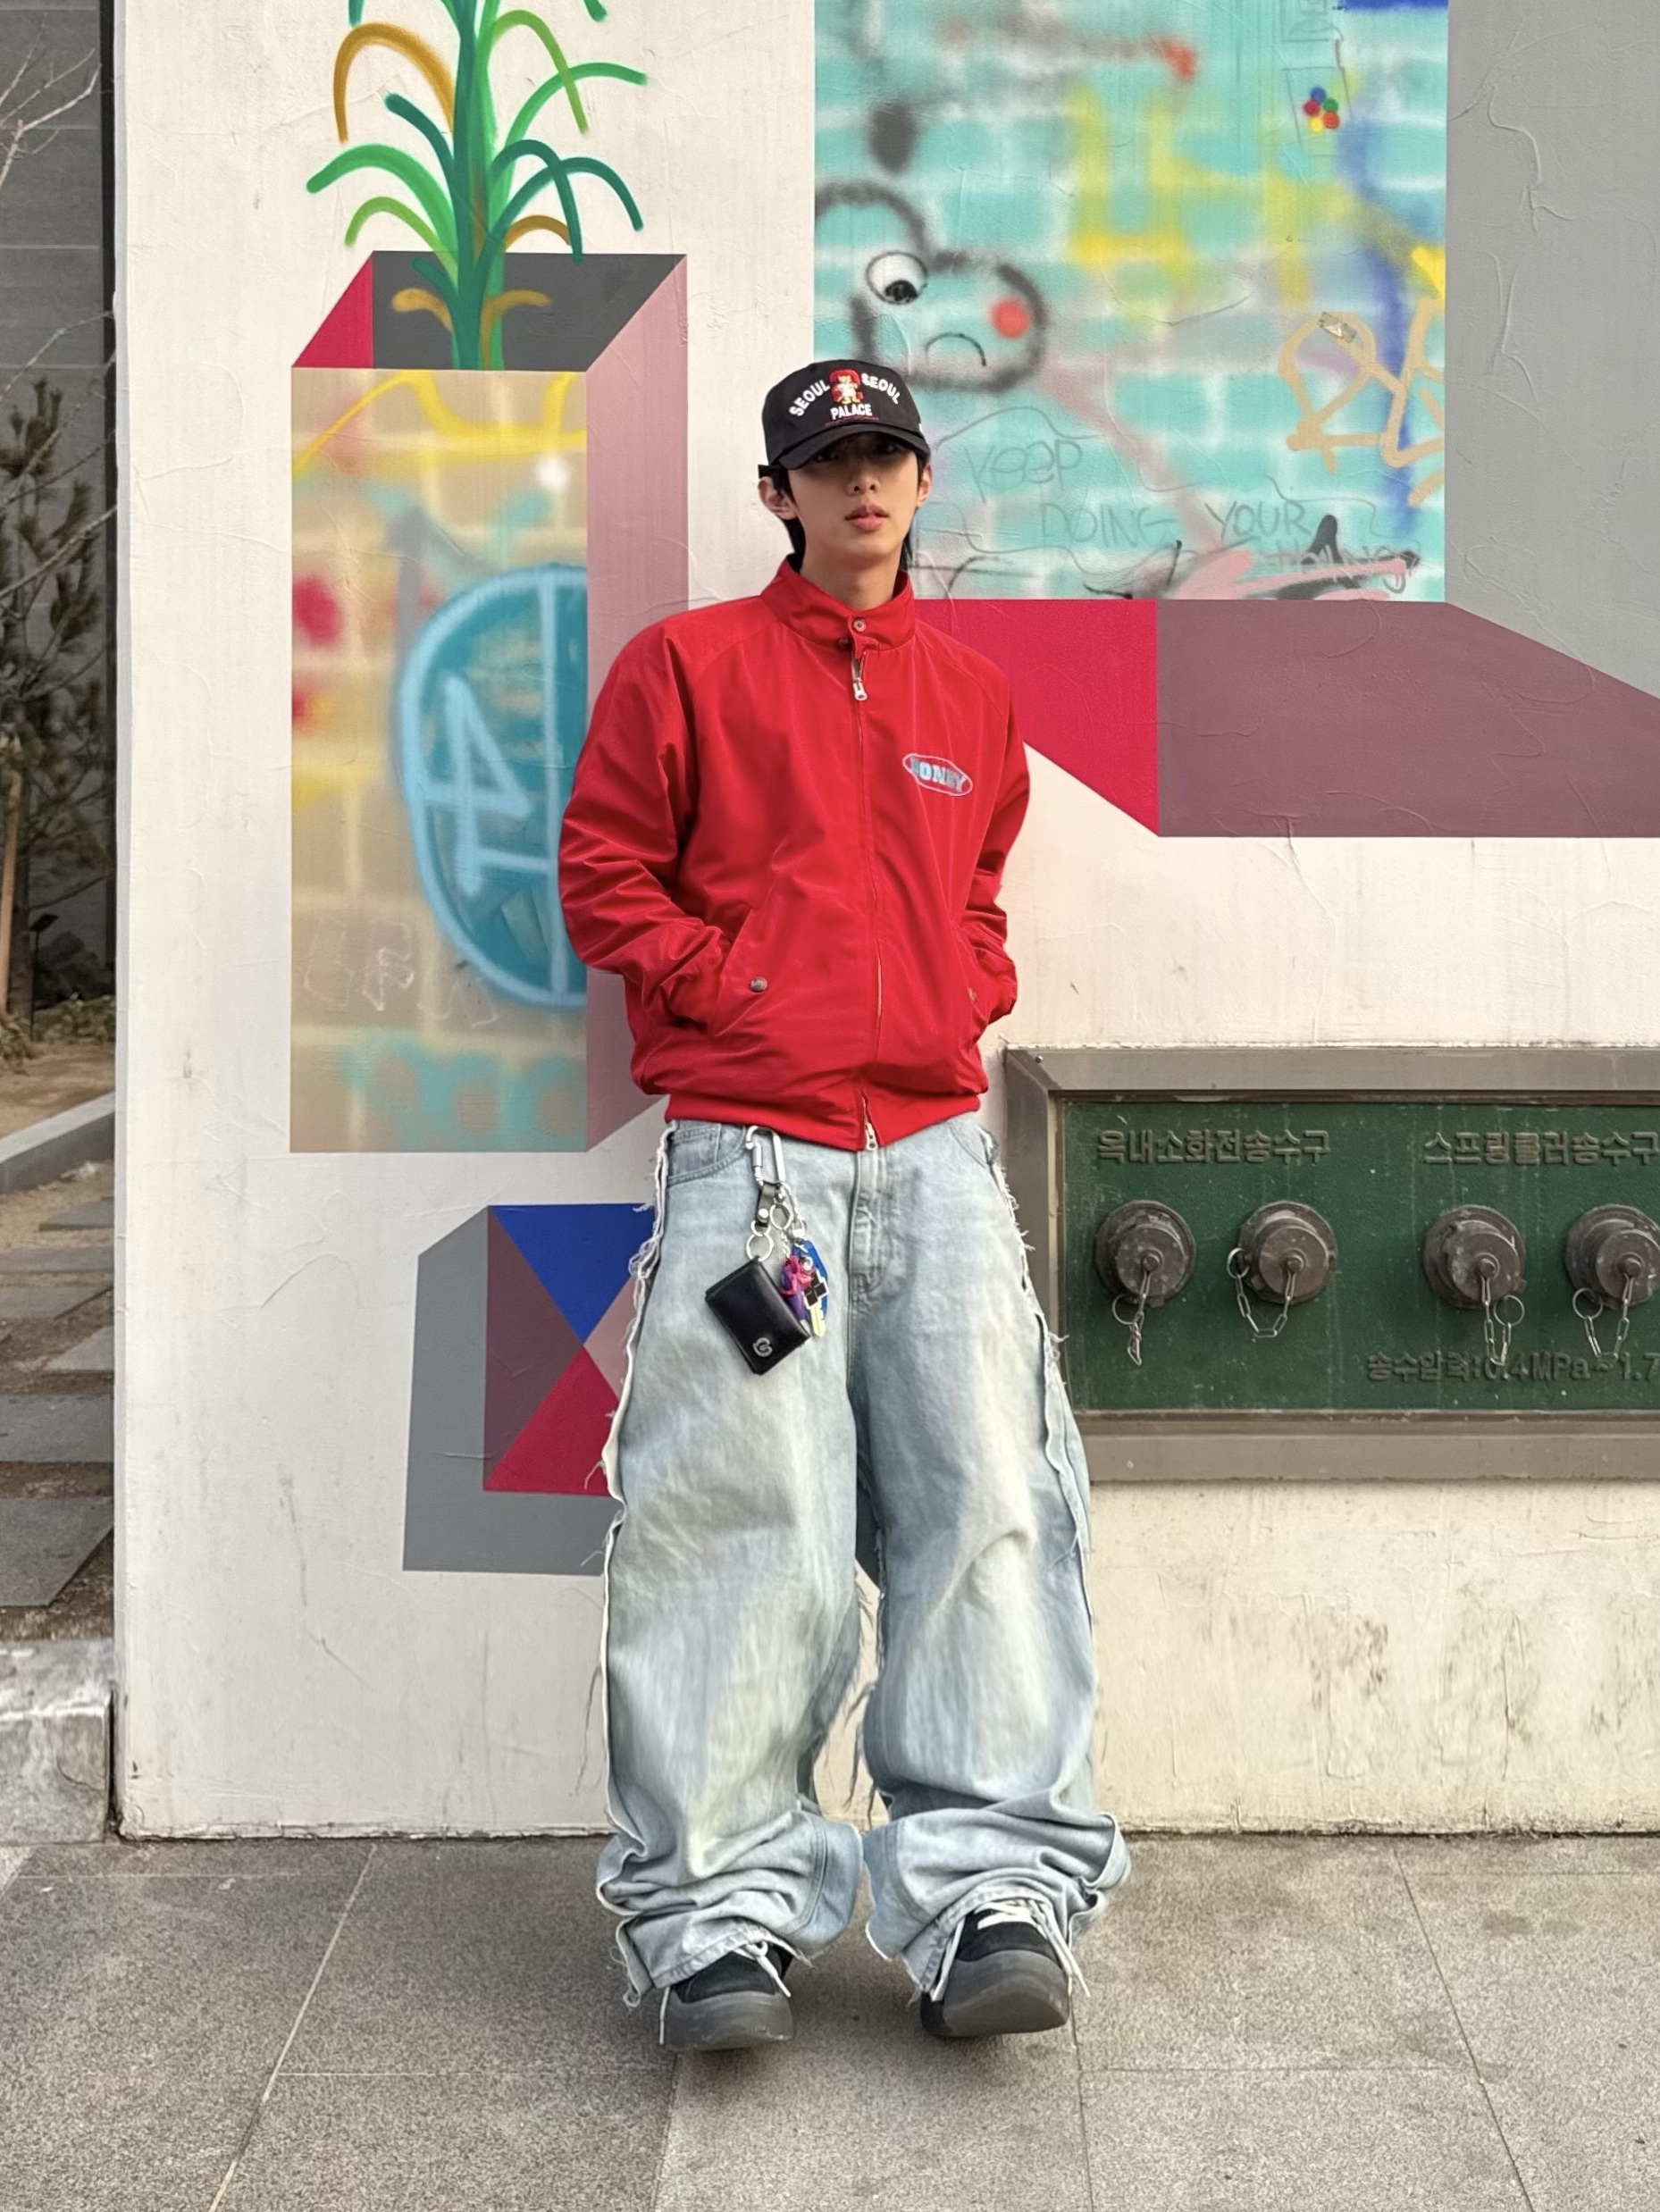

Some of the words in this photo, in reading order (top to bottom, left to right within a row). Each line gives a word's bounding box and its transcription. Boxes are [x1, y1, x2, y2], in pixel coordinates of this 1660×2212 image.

[789, 379, 831, 417] SEOUL
[860, 373, 902, 405] SEOUL
[830, 403, 872, 421] PALACE
[1205, 499, 1313, 540] YOUR
[1097, 1128, 1331, 1166] 옥내소화전송수구
[1423, 1130, 1660, 1167] 스프링클러송수구
